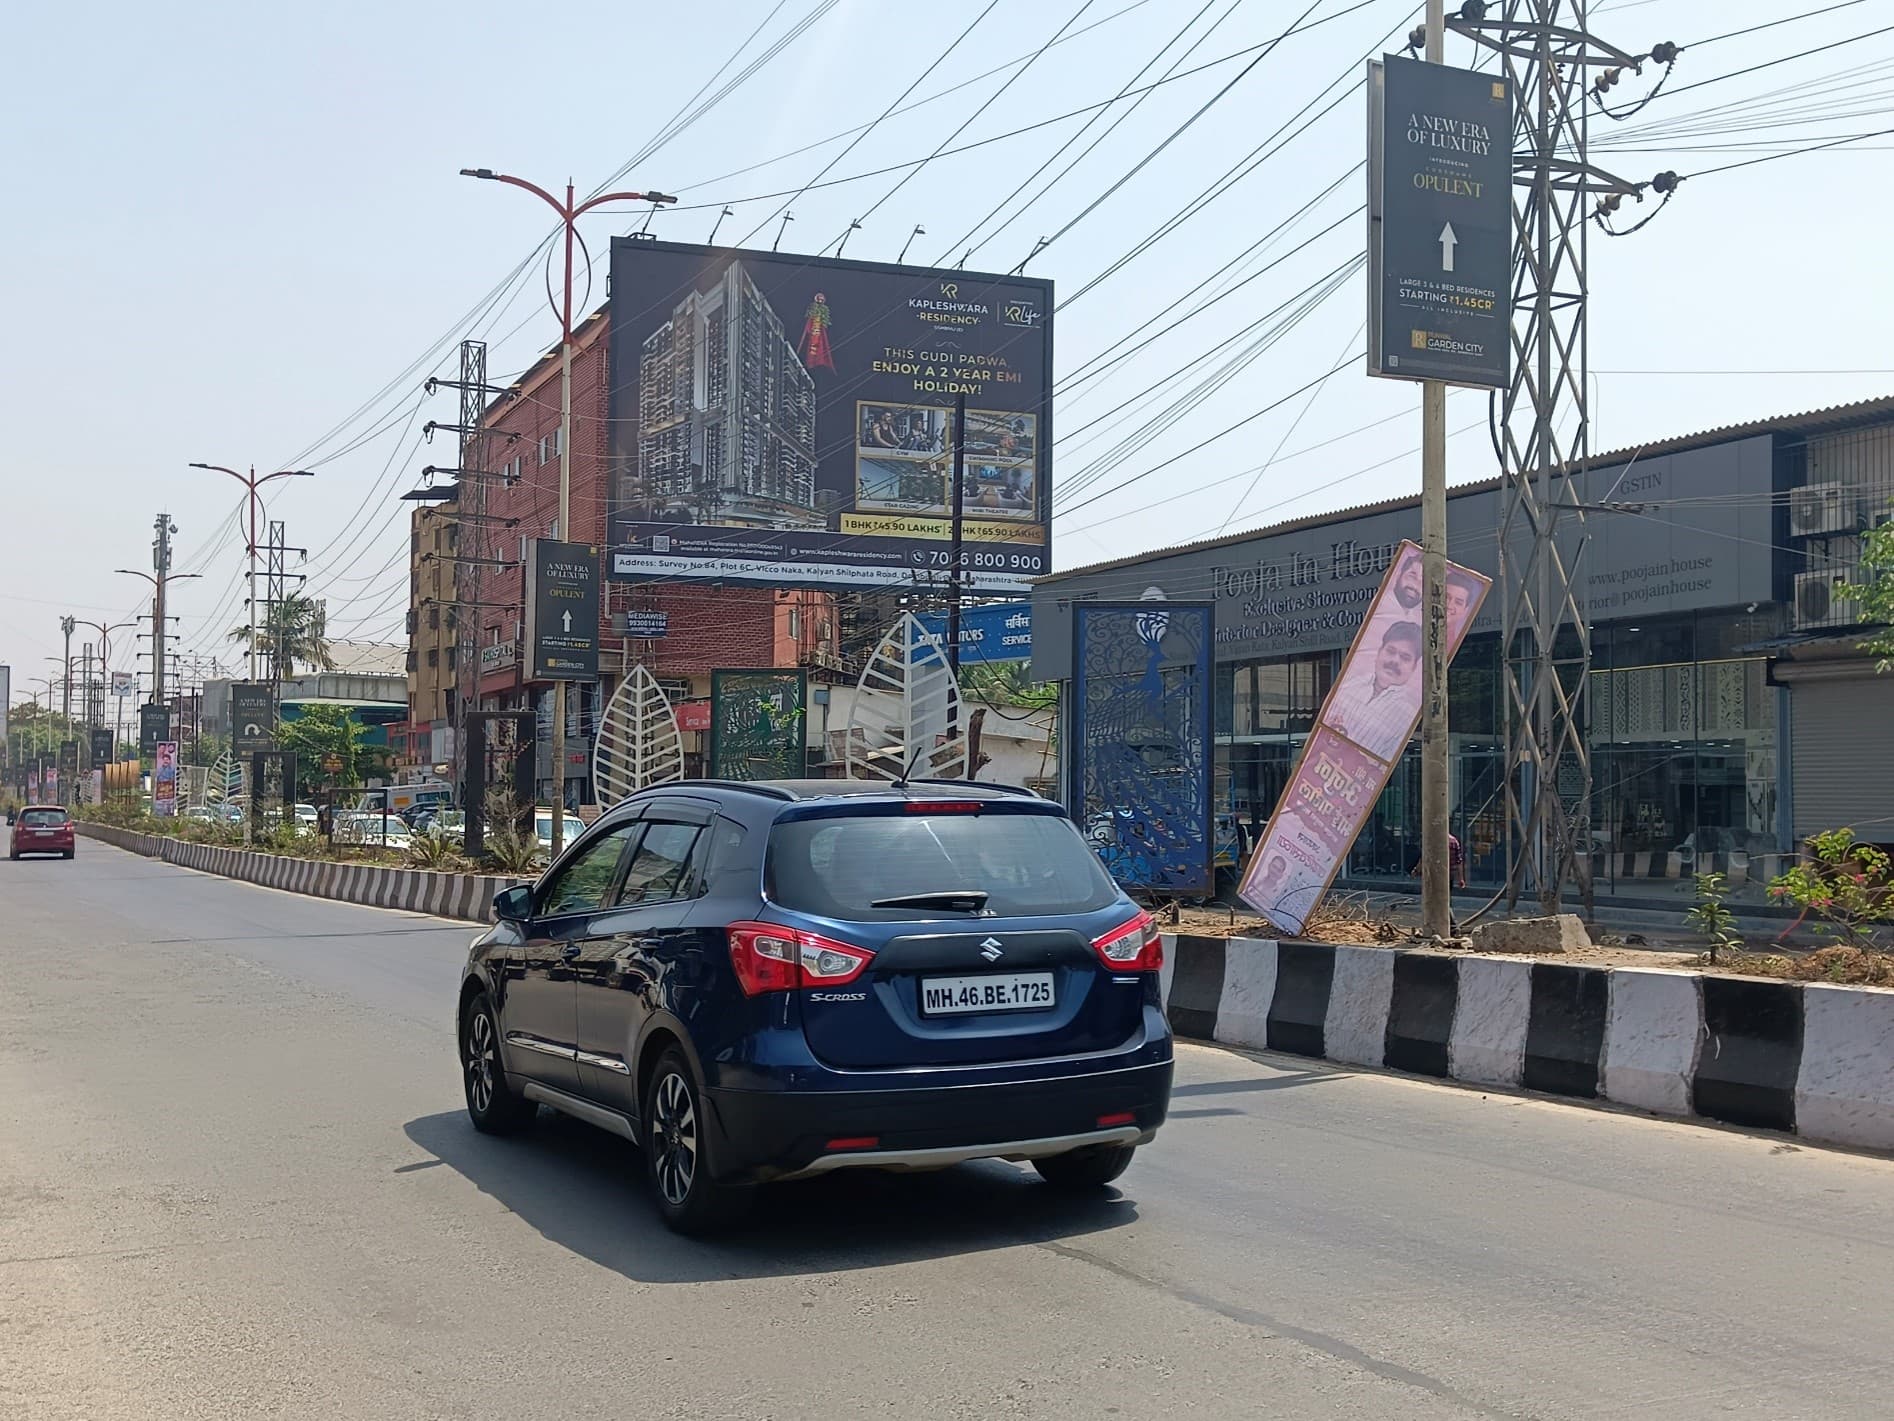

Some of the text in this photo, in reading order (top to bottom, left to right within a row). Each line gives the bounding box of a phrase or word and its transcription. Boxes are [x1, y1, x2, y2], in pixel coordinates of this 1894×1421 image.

[1408, 113, 1489, 140] A NEW ERA
[1407, 128, 1491, 155] OF LUXURY
[1413, 172, 1484, 198] OPULENT
[1399, 278, 1421, 287] LARGE
[1441, 284, 1455, 292] BED
[1456, 286, 1496, 298] RESIDENCES
[1399, 288, 1447, 303] STARTING
[908, 298, 988, 314] KAPLESHWARA
[1427, 338, 1464, 351] GARDEN
[1465, 343, 1485, 354] CITY
[884, 347, 1008, 367] THIS GUDI PADWA
[872, 361, 1022, 383] ENJOY A 2 YEAR EMI
[913, 379, 982, 395] HOLIDAY!
[1619, 472, 1663, 495] GSTIN
[547, 562, 589, 573] A NEW ERA
[930, 551, 1042, 570] 706 800 900
[558, 571, 590, 580] LUXURY
[619, 559, 656, 568] Address:
[659, 560, 688, 570] Survey
[720, 563, 738, 571] Plot
[756, 565, 779, 573] Vicco
[806, 567, 834, 577] Kalyan
[836, 569, 874, 578] Shilphata
[966, 575, 1012, 584] aharashtra
[1211, 559, 1283, 602] Pooja
[549, 588, 585, 599] OPULENT
[627, 611, 668, 621] MEDIAWISE
[1243, 595, 1305, 618] Exclusive
[1262, 616, 1319, 638] Designer
[1322, 612, 1336, 629] &
[1002, 634, 1032, 646] SERVICE
[926, 982, 1050, 1009] MH.46.BE.1725
